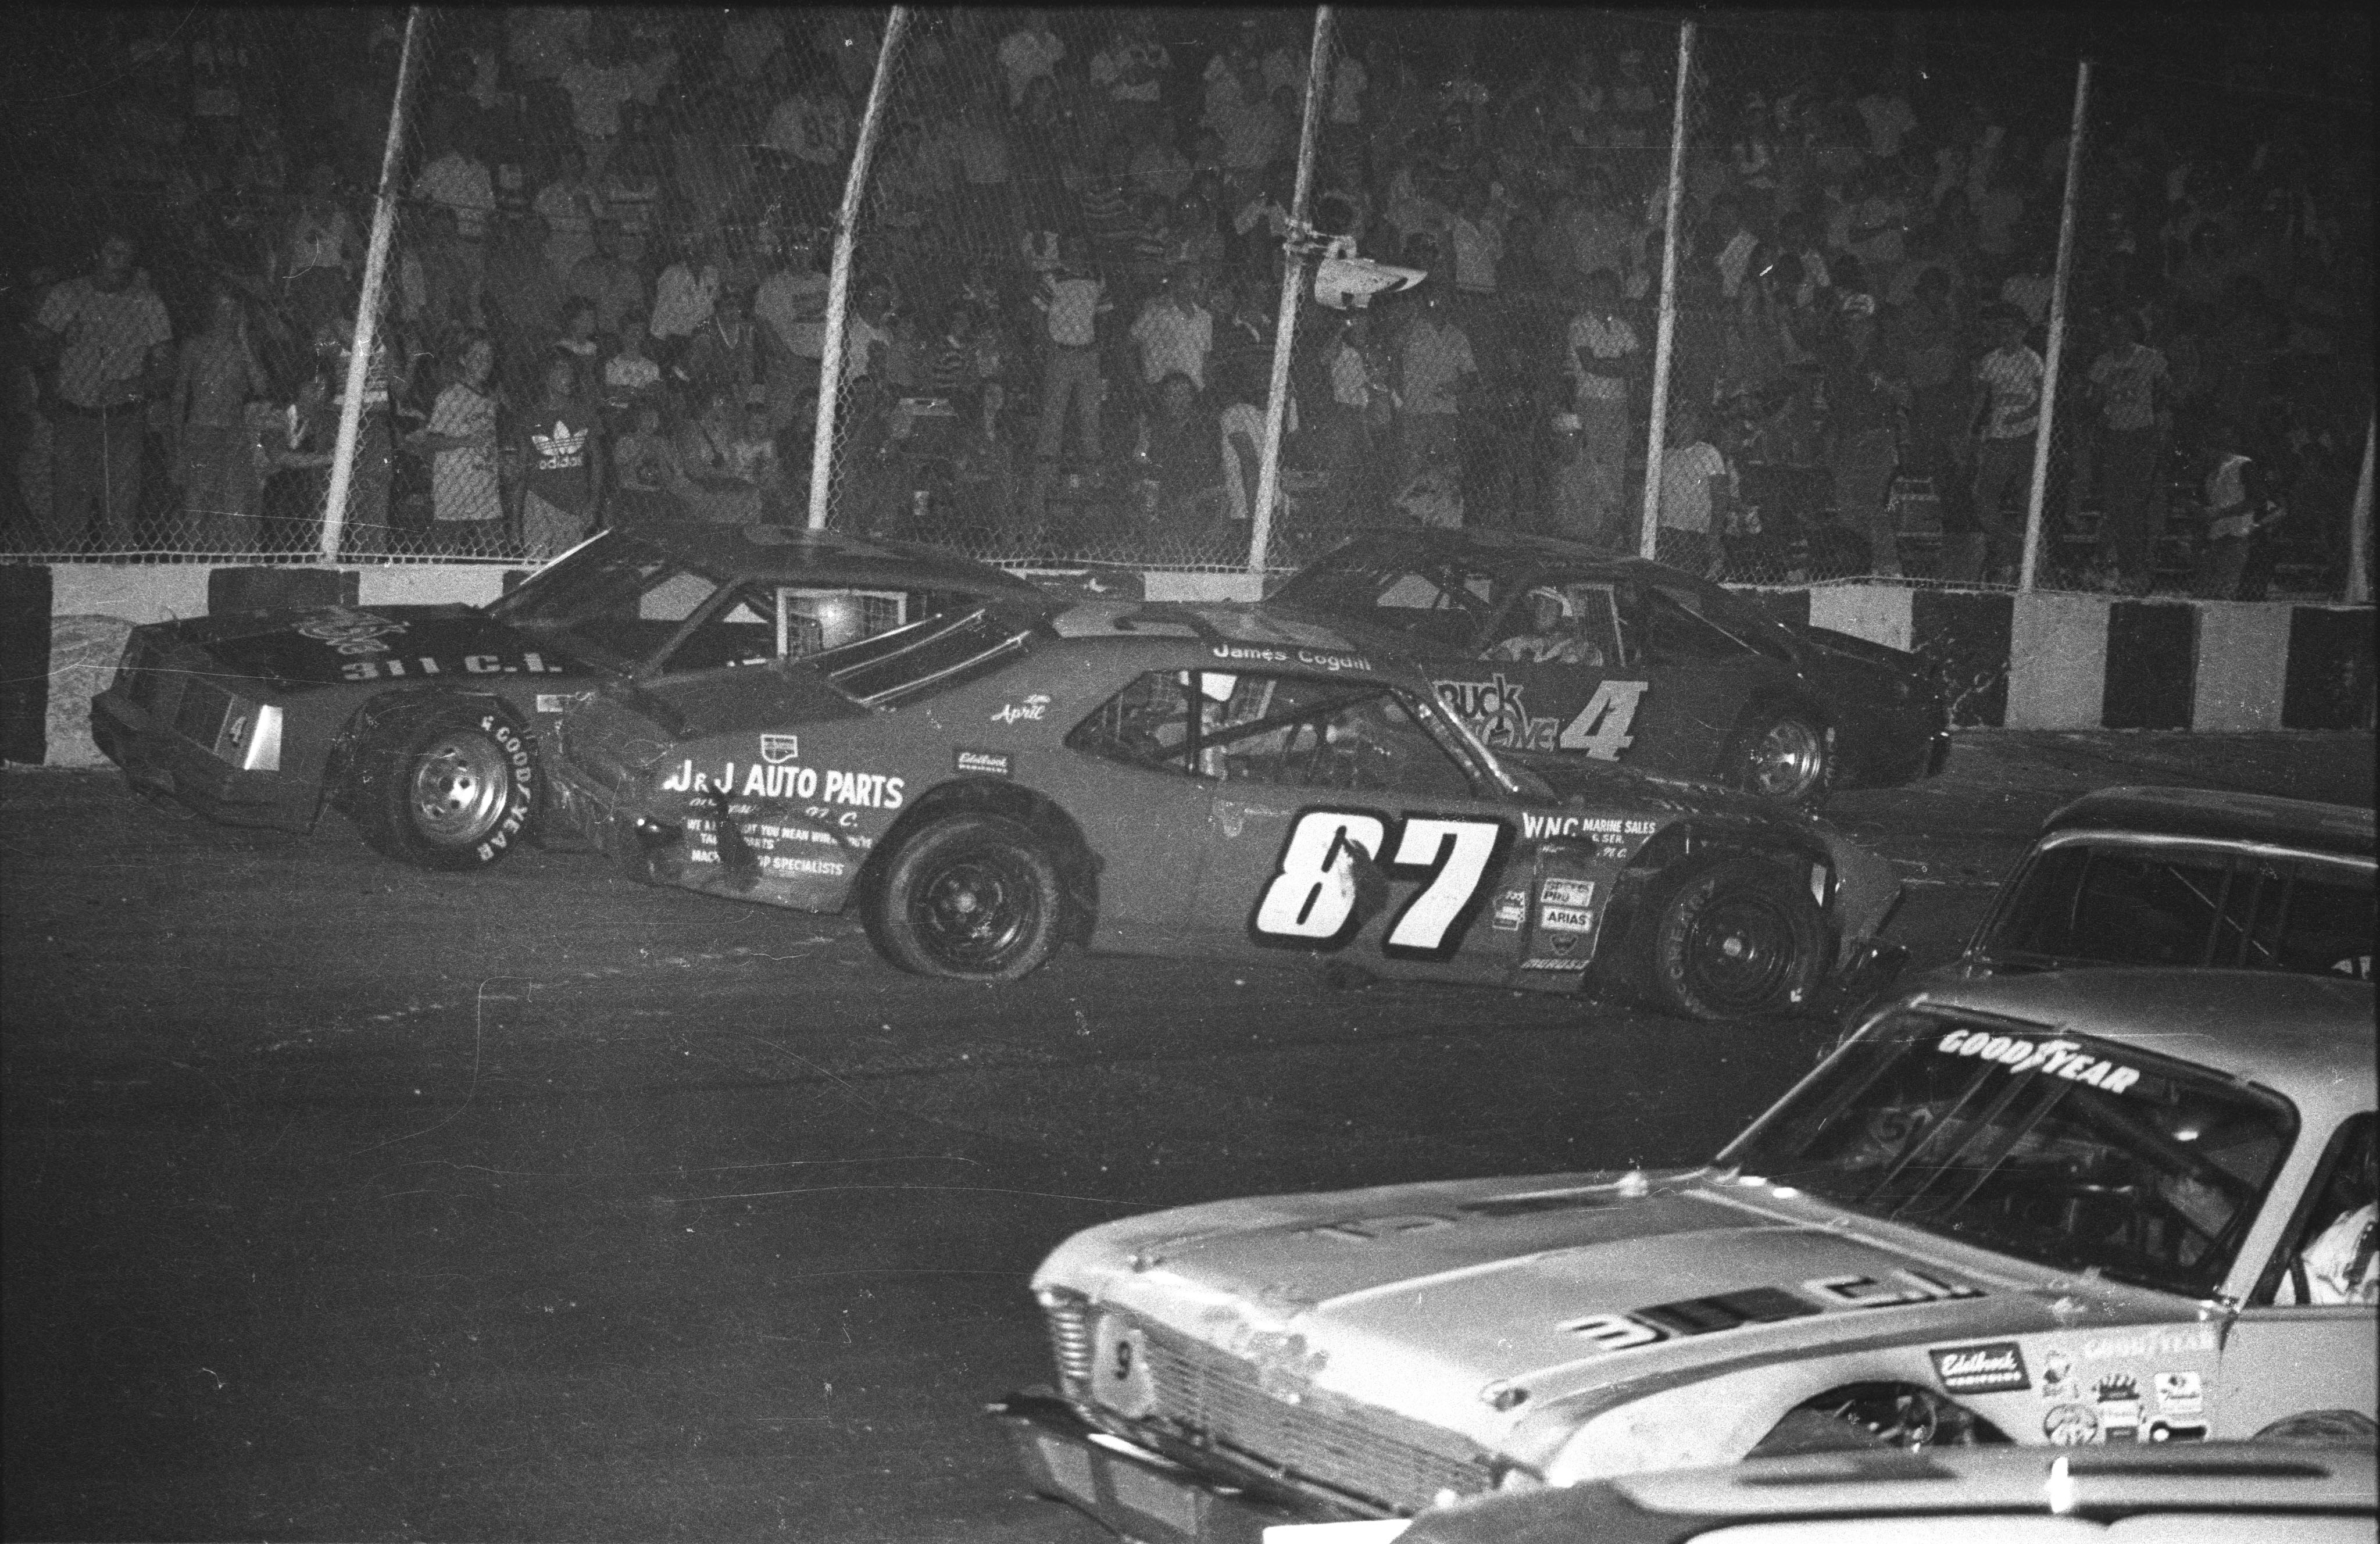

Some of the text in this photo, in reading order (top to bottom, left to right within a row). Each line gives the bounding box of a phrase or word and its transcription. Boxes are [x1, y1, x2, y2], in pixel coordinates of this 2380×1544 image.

[1213, 643, 1288, 662] James
[989, 703, 1046, 725] April
[1560, 680, 1649, 762] 4
[742, 763, 817, 798] AUTO
[823, 770, 905, 809] PARTS
[760, 824, 780, 838] YOU
[781, 827, 809, 842] MEAN
[1582, 818, 1624, 833] MARINE
[1624, 820, 1656, 834] SALES
[772, 856, 845, 876] SPECIALISTS
[1254, 810, 1501, 952] 87
[1547, 910, 1587, 925] ARIAS
[1938, 1029, 2140, 1093] GOODYEAR
[1117, 1341, 1132, 1380] 9
[1941, 1350, 2018, 1378] Edelbrock
